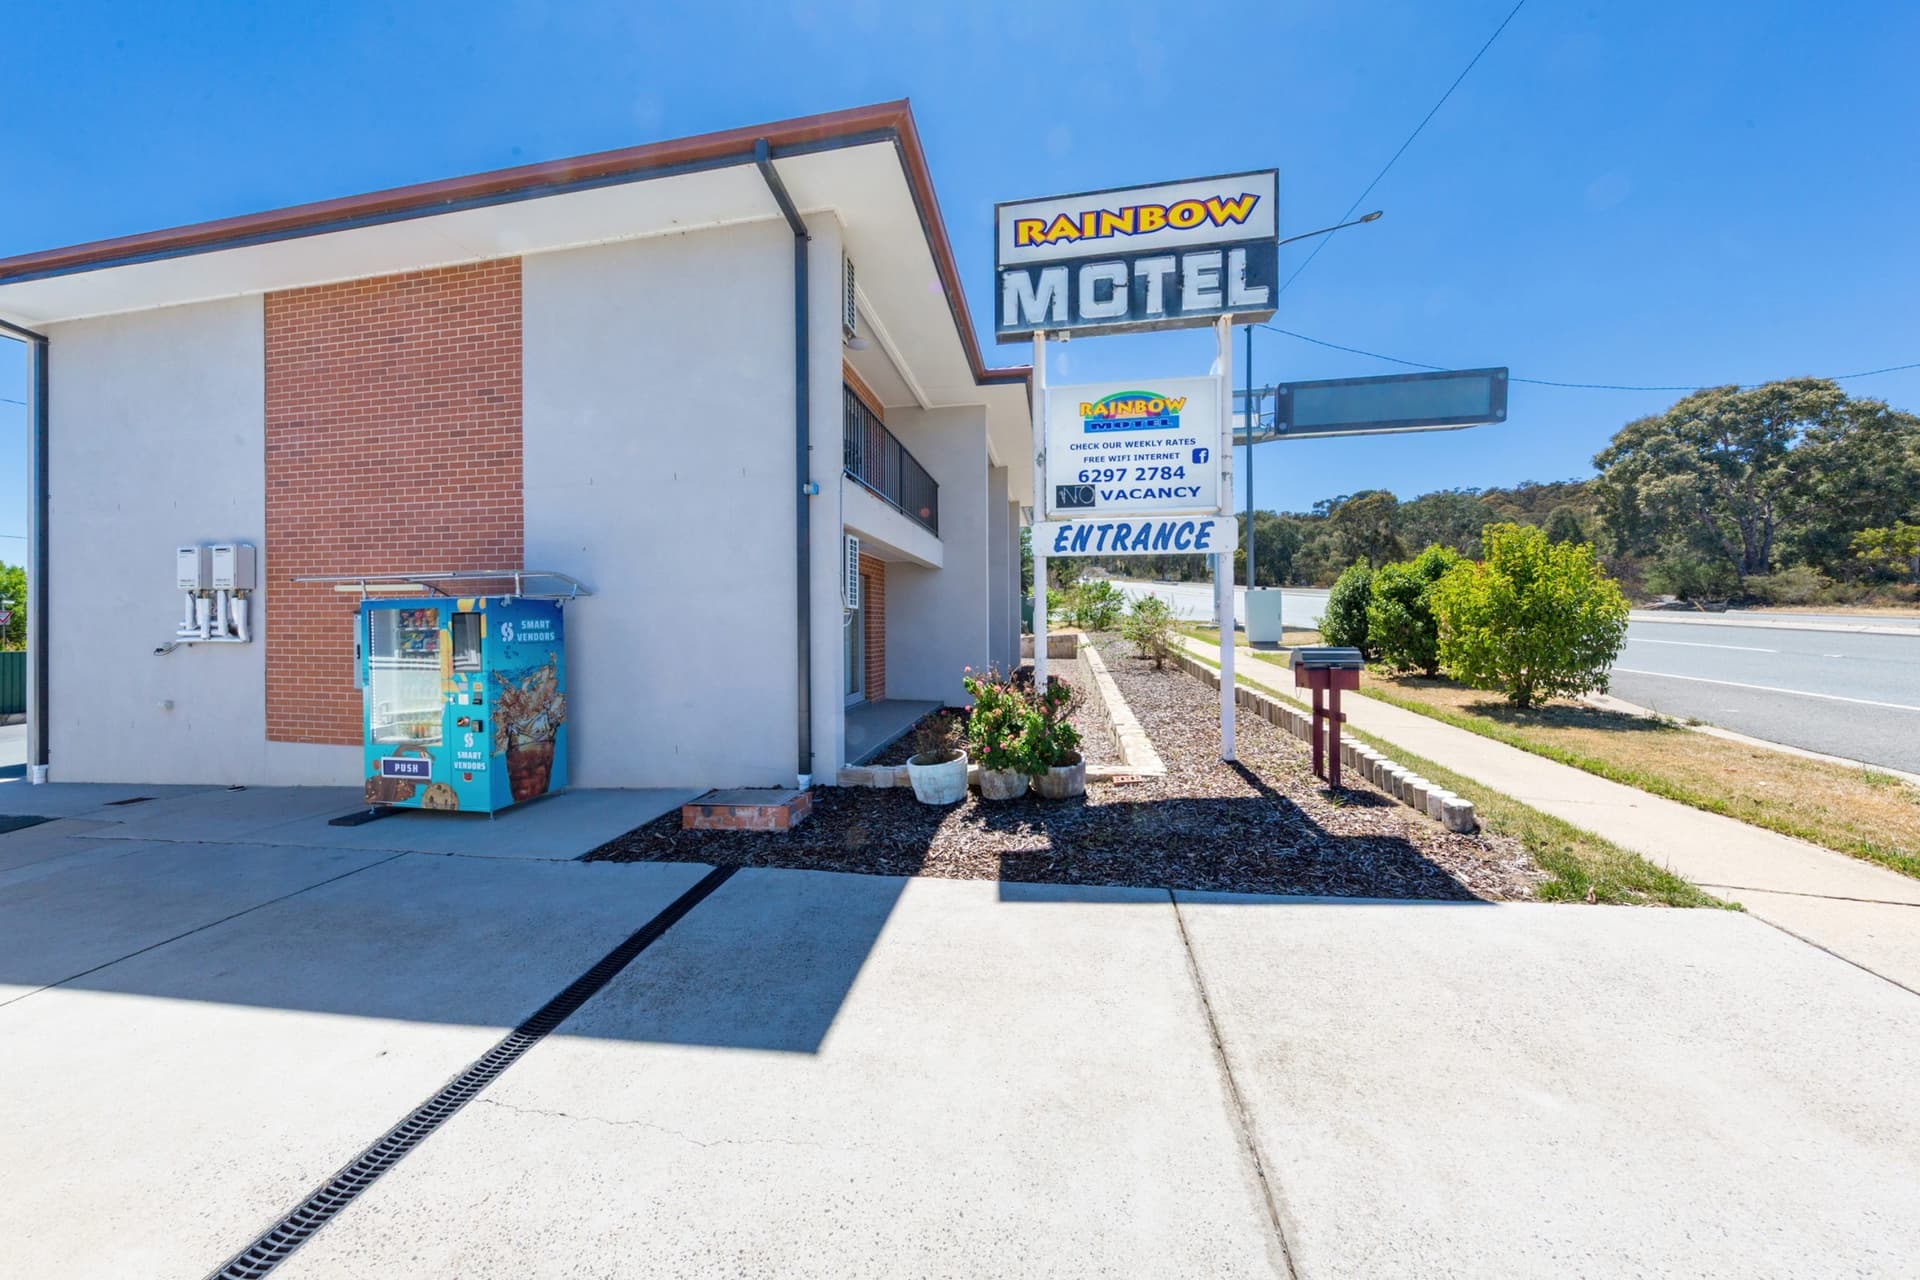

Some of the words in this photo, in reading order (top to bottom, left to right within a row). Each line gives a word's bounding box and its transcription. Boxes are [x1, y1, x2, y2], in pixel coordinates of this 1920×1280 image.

[1014, 192, 1261, 247] RAINBOW
[1002, 248, 1269, 326] MOTEL
[1079, 396, 1187, 416] RAINBOW
[1090, 419, 1172, 430] MOTEL
[1070, 443, 1099, 451] CHECK
[1125, 440, 1163, 448] WEEKLY
[1165, 438, 1196, 446] RATES
[1083, 455, 1105, 463] FREE
[1108, 454, 1130, 462] WIFI
[1134, 452, 1180, 461] INTERNET
[1078, 468, 1127, 483] 6297
[1135, 466, 1186, 481] 2784
[1059, 485, 1095, 504] NO
[1100, 486, 1201, 501] VACANCY
[1053, 521, 1215, 553] ENTRANCE
[521, 620, 550, 630] SMART
[516, 632, 556, 642] VENDORS
[457, 751, 482, 759] SMART
[394, 762, 419, 773] PUSH
[454, 761, 486, 770] VENDORS
